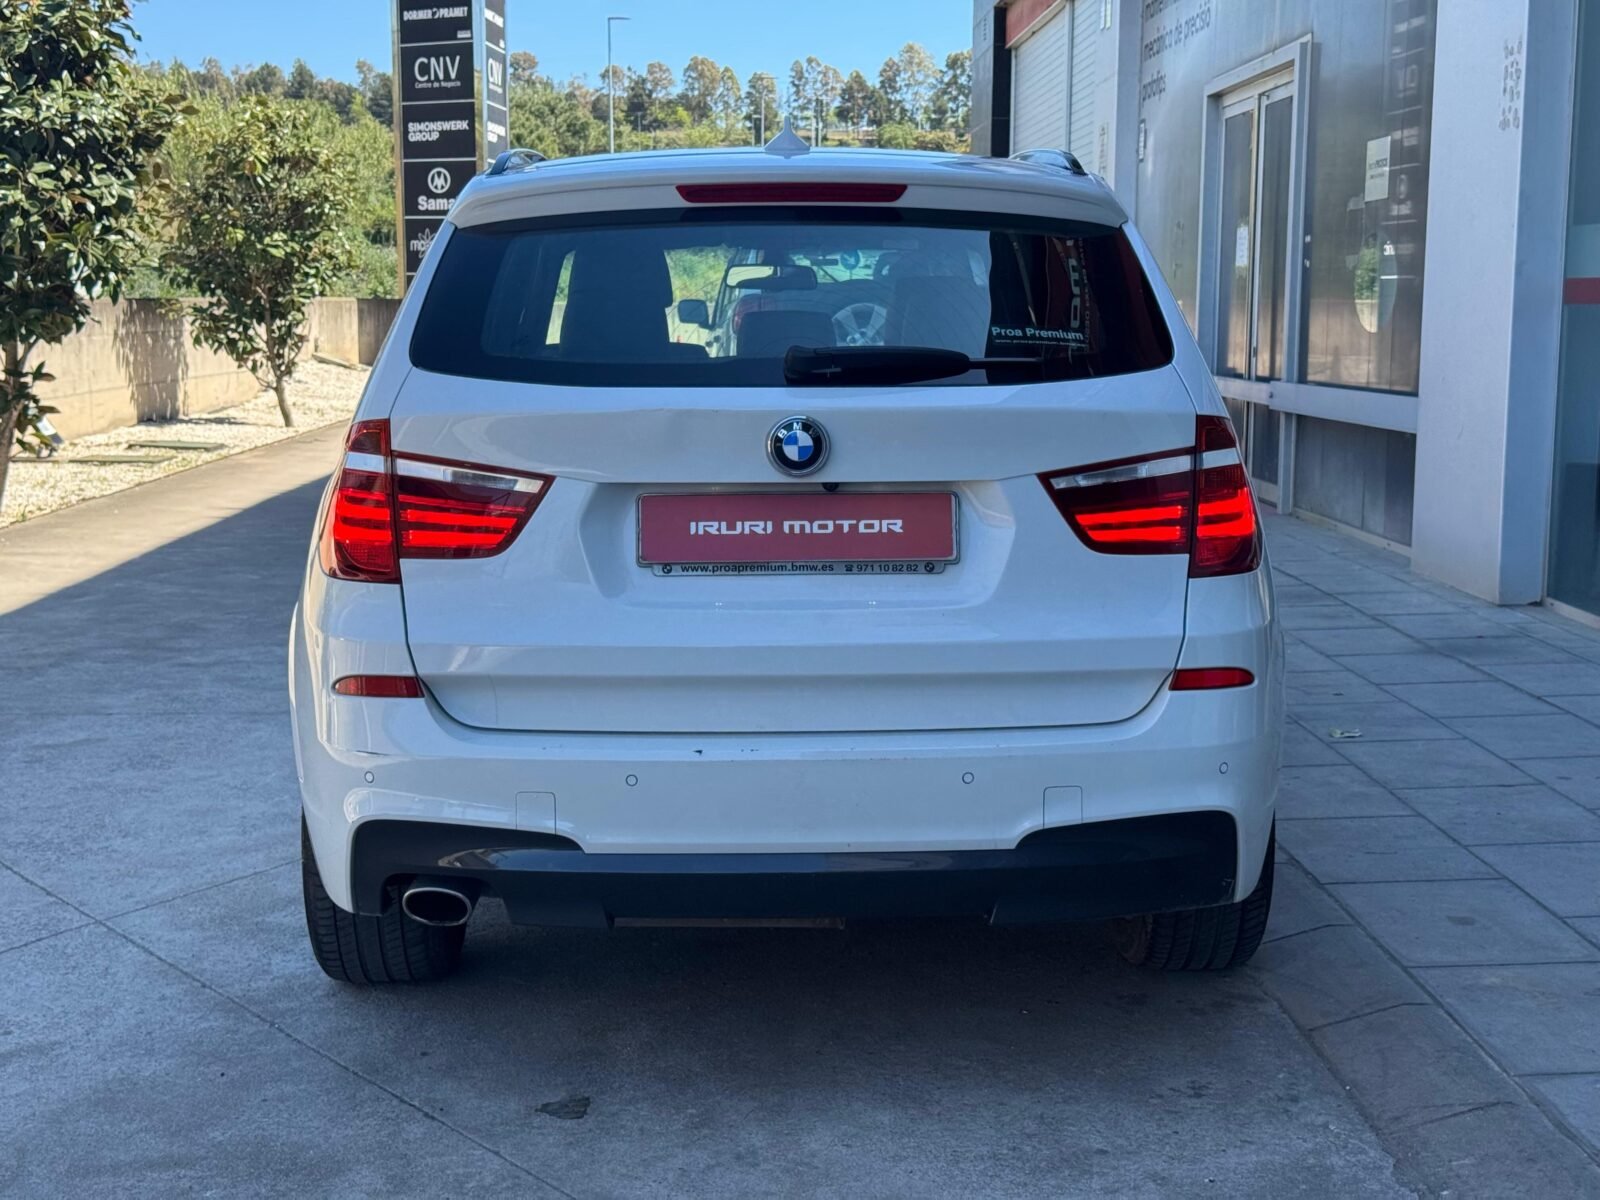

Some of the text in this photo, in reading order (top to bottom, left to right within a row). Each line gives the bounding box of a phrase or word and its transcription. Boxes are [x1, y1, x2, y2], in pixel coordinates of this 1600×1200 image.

[403, 6, 468, 21] DORMER PRAMET
[1174, 18, 1183, 46] de
[414, 55, 460, 82] CNV
[408, 120, 469, 132] SIMONSWERK
[408, 132, 439, 142] GROUP
[417, 195, 457, 211] Sama
[991, 326, 1084, 341] Proa Premium
[777, 421, 820, 439] BMW
[689, 519, 903, 535] IRURI MOTOR
[681, 563, 919, 575] www.proapremium.bmw.es 971 10 82 82
